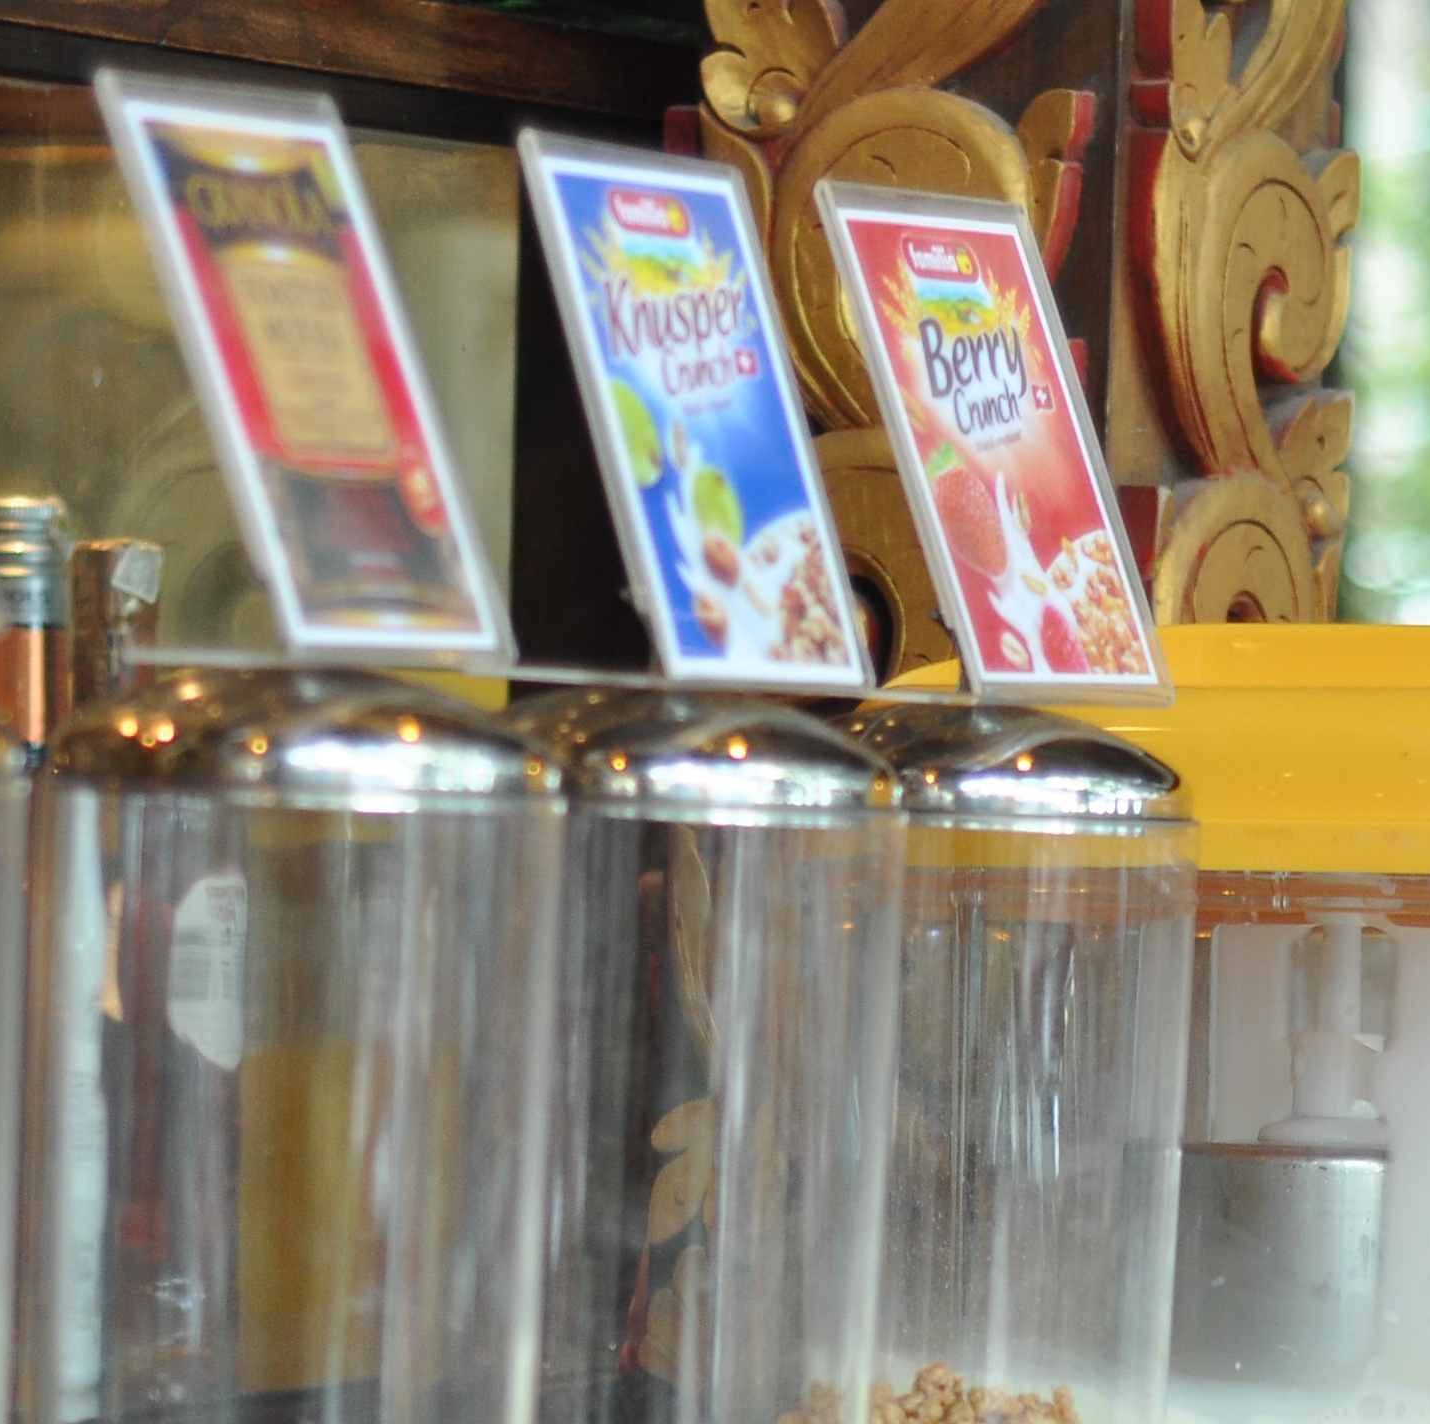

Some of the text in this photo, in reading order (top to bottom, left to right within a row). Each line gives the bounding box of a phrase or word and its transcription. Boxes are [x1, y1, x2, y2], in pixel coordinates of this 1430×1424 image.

[605, 277, 742, 359] Knusper
[918, 316, 1028, 399] Berry
[953, 378, 1022, 436] Crunch
